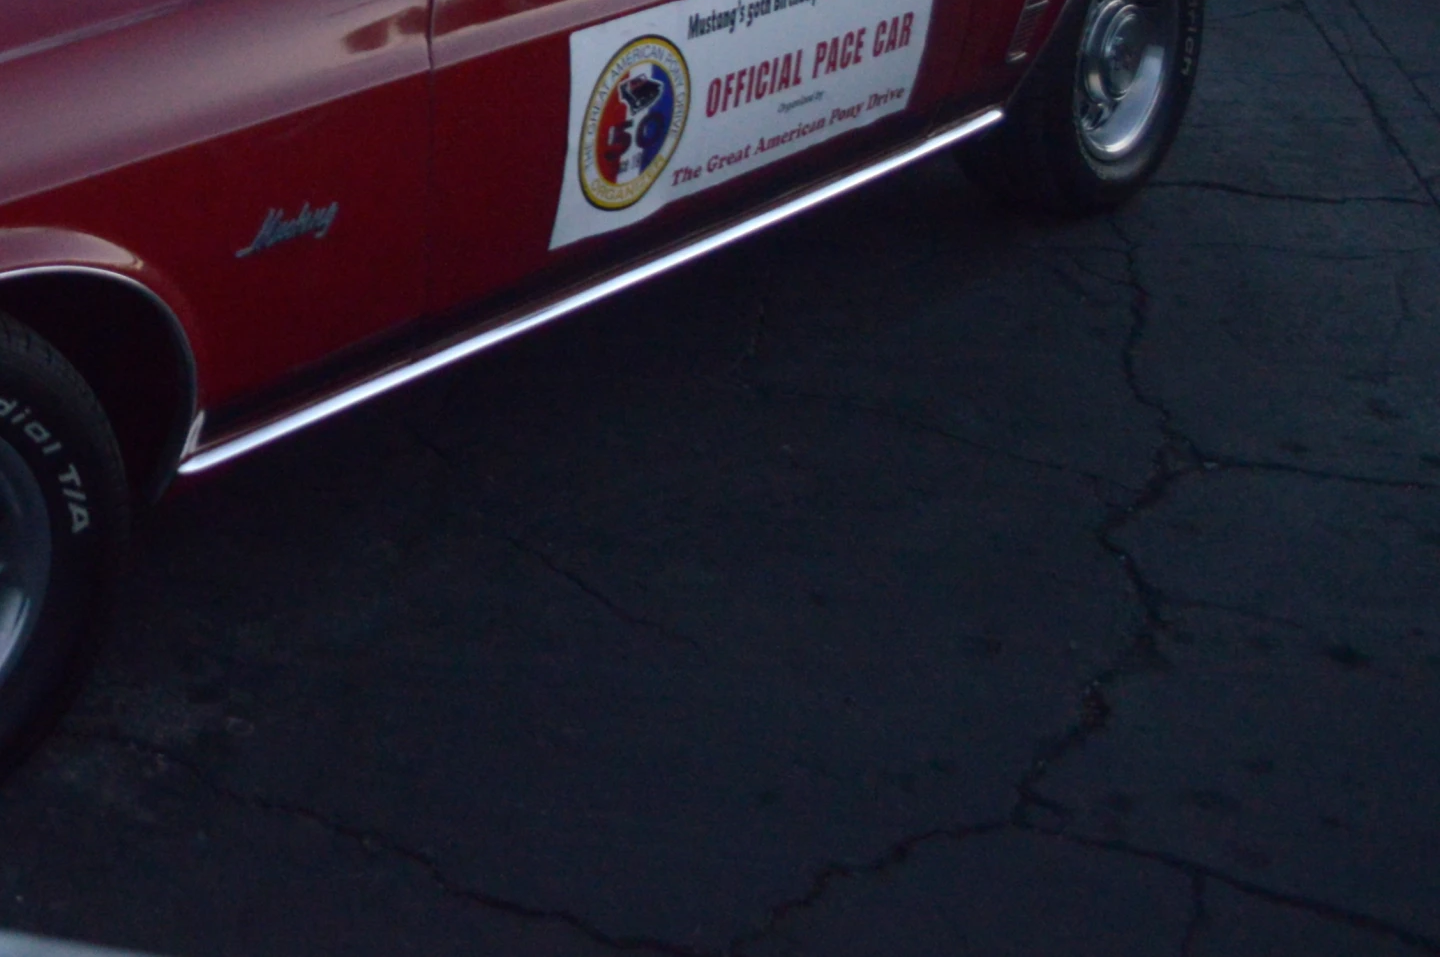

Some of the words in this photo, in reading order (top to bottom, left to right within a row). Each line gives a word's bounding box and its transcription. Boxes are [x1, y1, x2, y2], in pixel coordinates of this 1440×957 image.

[687, 0, 746, 40] Mustang's
[610, 45, 665, 81] AMERICAN
[705, 49, 803, 118] OFFICIAL
[812, 28, 866, 79] PACE
[872, 12, 915, 58] CAR
[671, 163, 702, 187] The
[707, 144, 751, 173] Great
[754, 117, 826, 155] American
[828, 101, 863, 127] Pony
[866, 86, 905, 111] Drive
[57, 464, 90, 535] T/A
